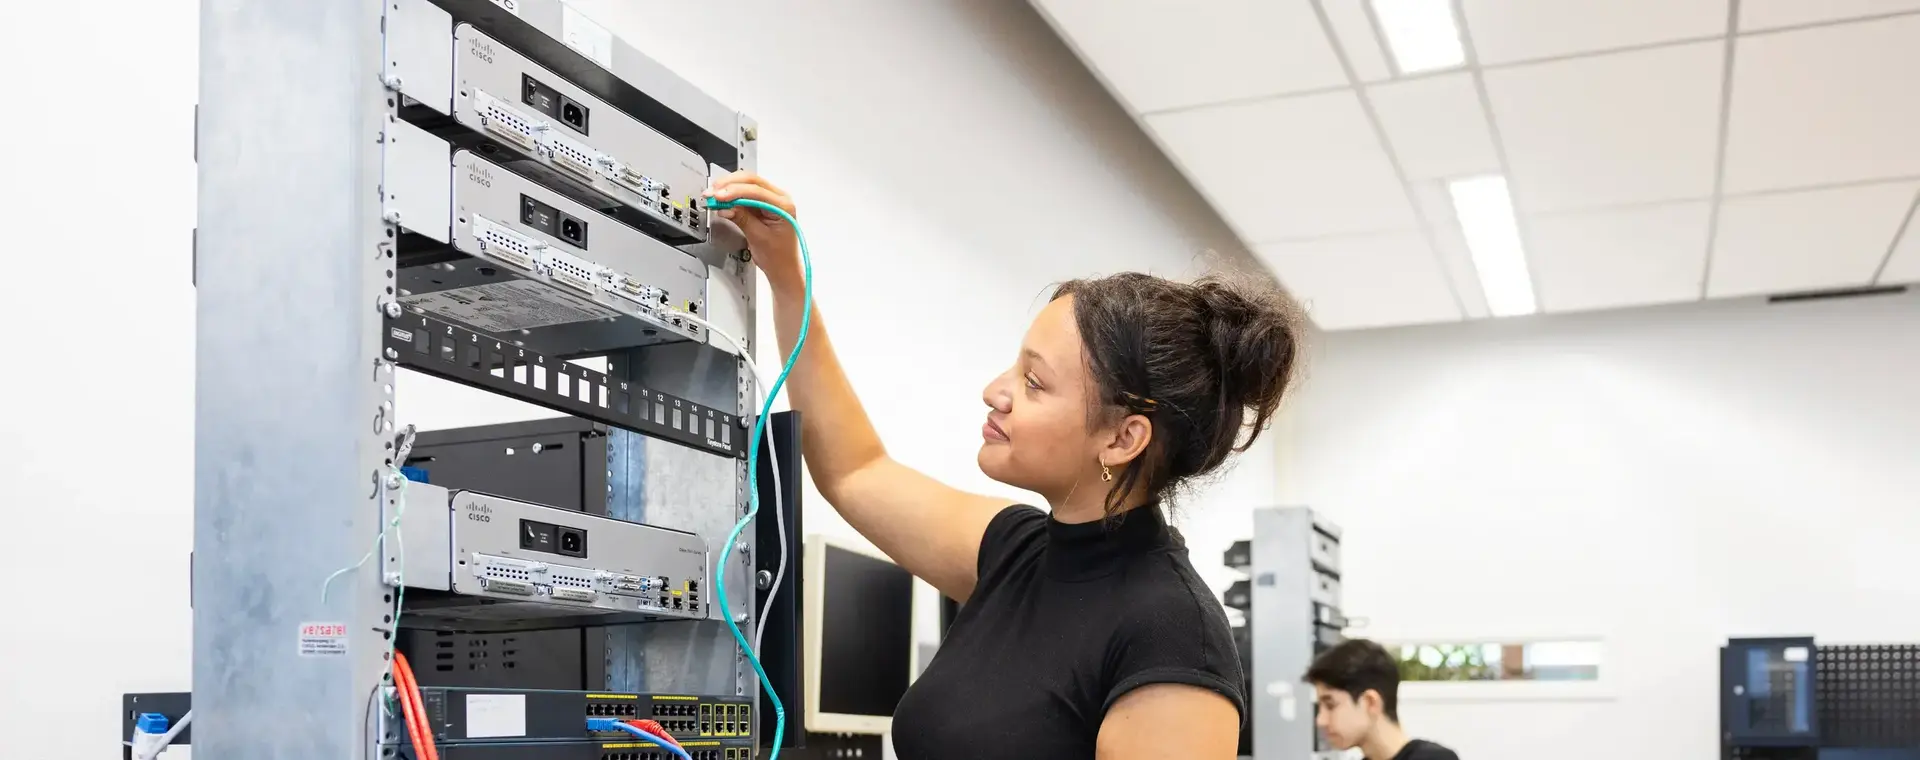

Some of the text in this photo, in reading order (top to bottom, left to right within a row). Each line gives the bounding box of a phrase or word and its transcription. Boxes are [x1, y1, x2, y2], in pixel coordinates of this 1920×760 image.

[471, 48, 493, 64] CISCO
[469, 173, 491, 188] CISCO
[421, 318, 427, 326] 1
[447, 326, 453, 335] 2
[471, 334, 477, 342] 3
[518, 349, 524, 357] 5
[538, 355, 544, 363] 6
[582, 370, 588, 378] 8
[602, 376, 607, 384] 9
[620, 382, 628, 390] 10
[642, 389, 648, 397] 11
[657, 394, 664, 402] 12
[707, 410, 714, 418] 15
[468, 513, 491, 523] CISCO
